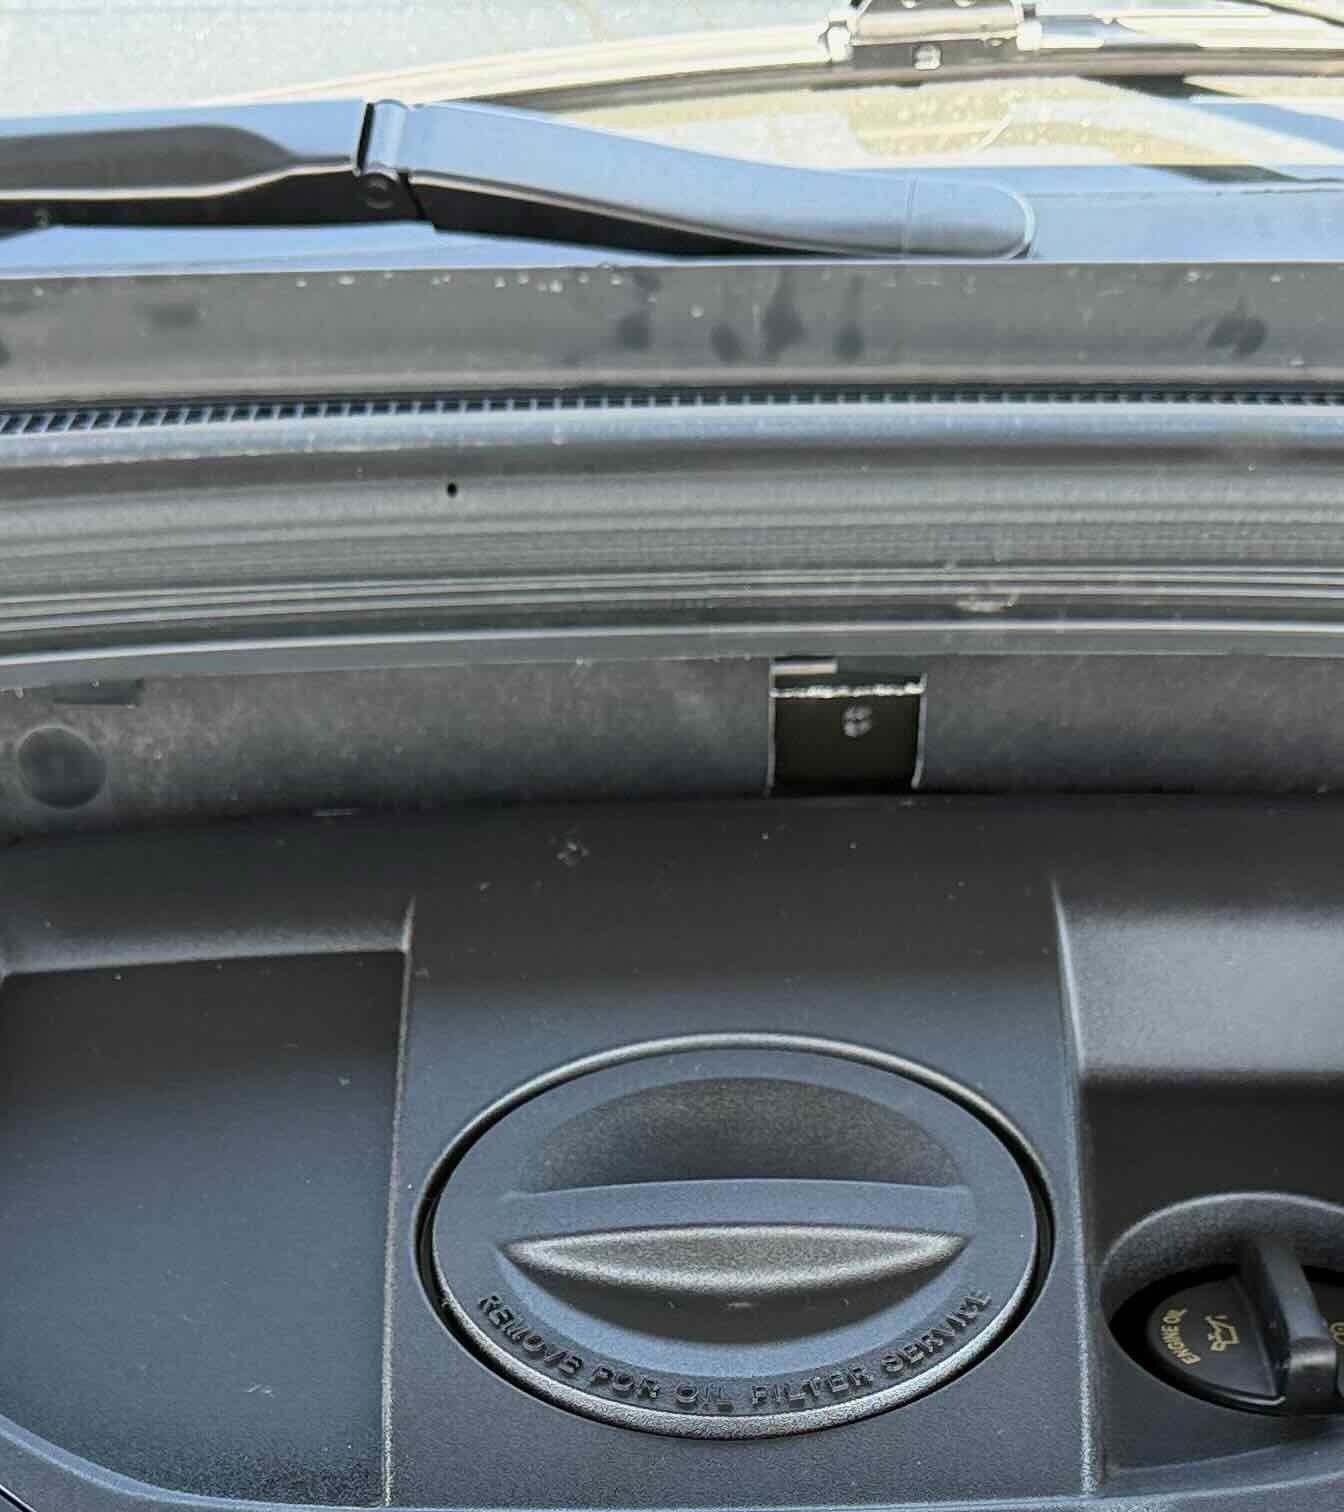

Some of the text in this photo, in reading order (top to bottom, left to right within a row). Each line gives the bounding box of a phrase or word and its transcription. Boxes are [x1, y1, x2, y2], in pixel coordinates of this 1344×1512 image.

[478, 1289, 992, 1412] REMOVE FOR OIL FILTER SERVICE
[1160, 1325, 1201, 1364] ENGINE
